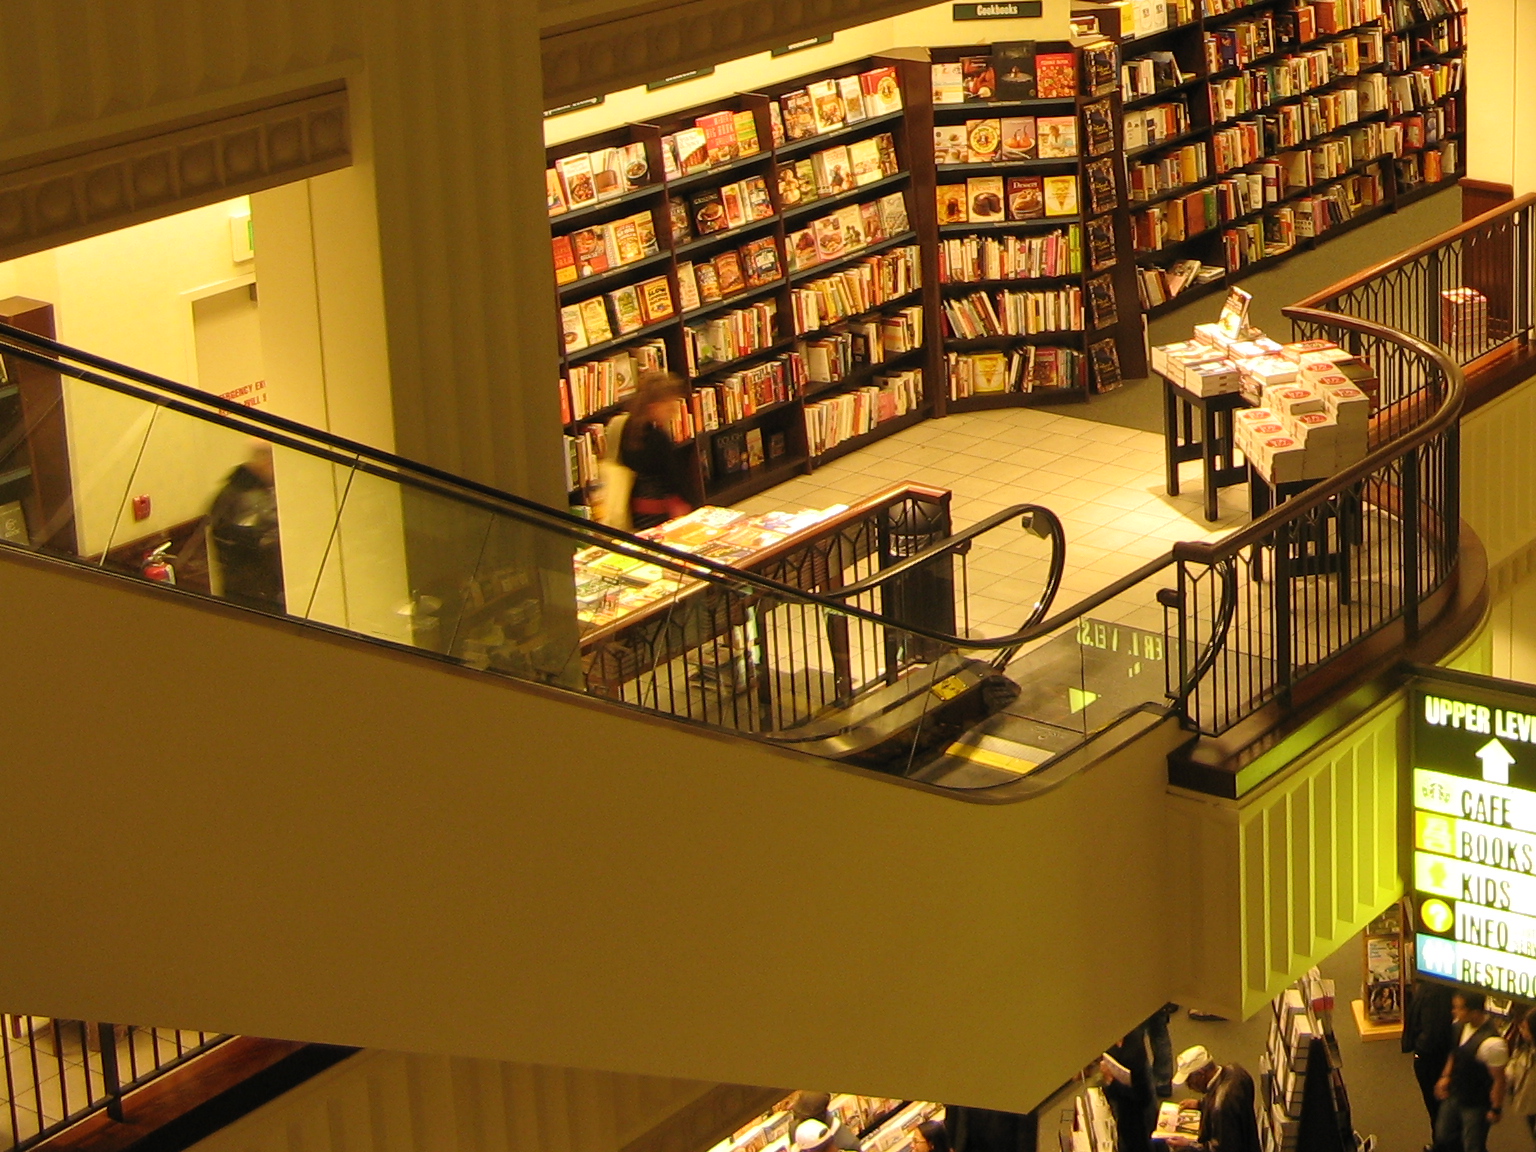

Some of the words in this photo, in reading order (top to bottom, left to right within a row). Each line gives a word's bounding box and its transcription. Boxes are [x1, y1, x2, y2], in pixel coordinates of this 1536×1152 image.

[976, 4, 1018, 16] Cookbooks
[1425, 695, 1491, 735] UPPER
[1461, 790, 1512, 827] CAFE
[1461, 831, 1533, 874] BOOKS
[1461, 872, 1511, 911] KIDS
[1461, 913, 1509, 950] INFO
